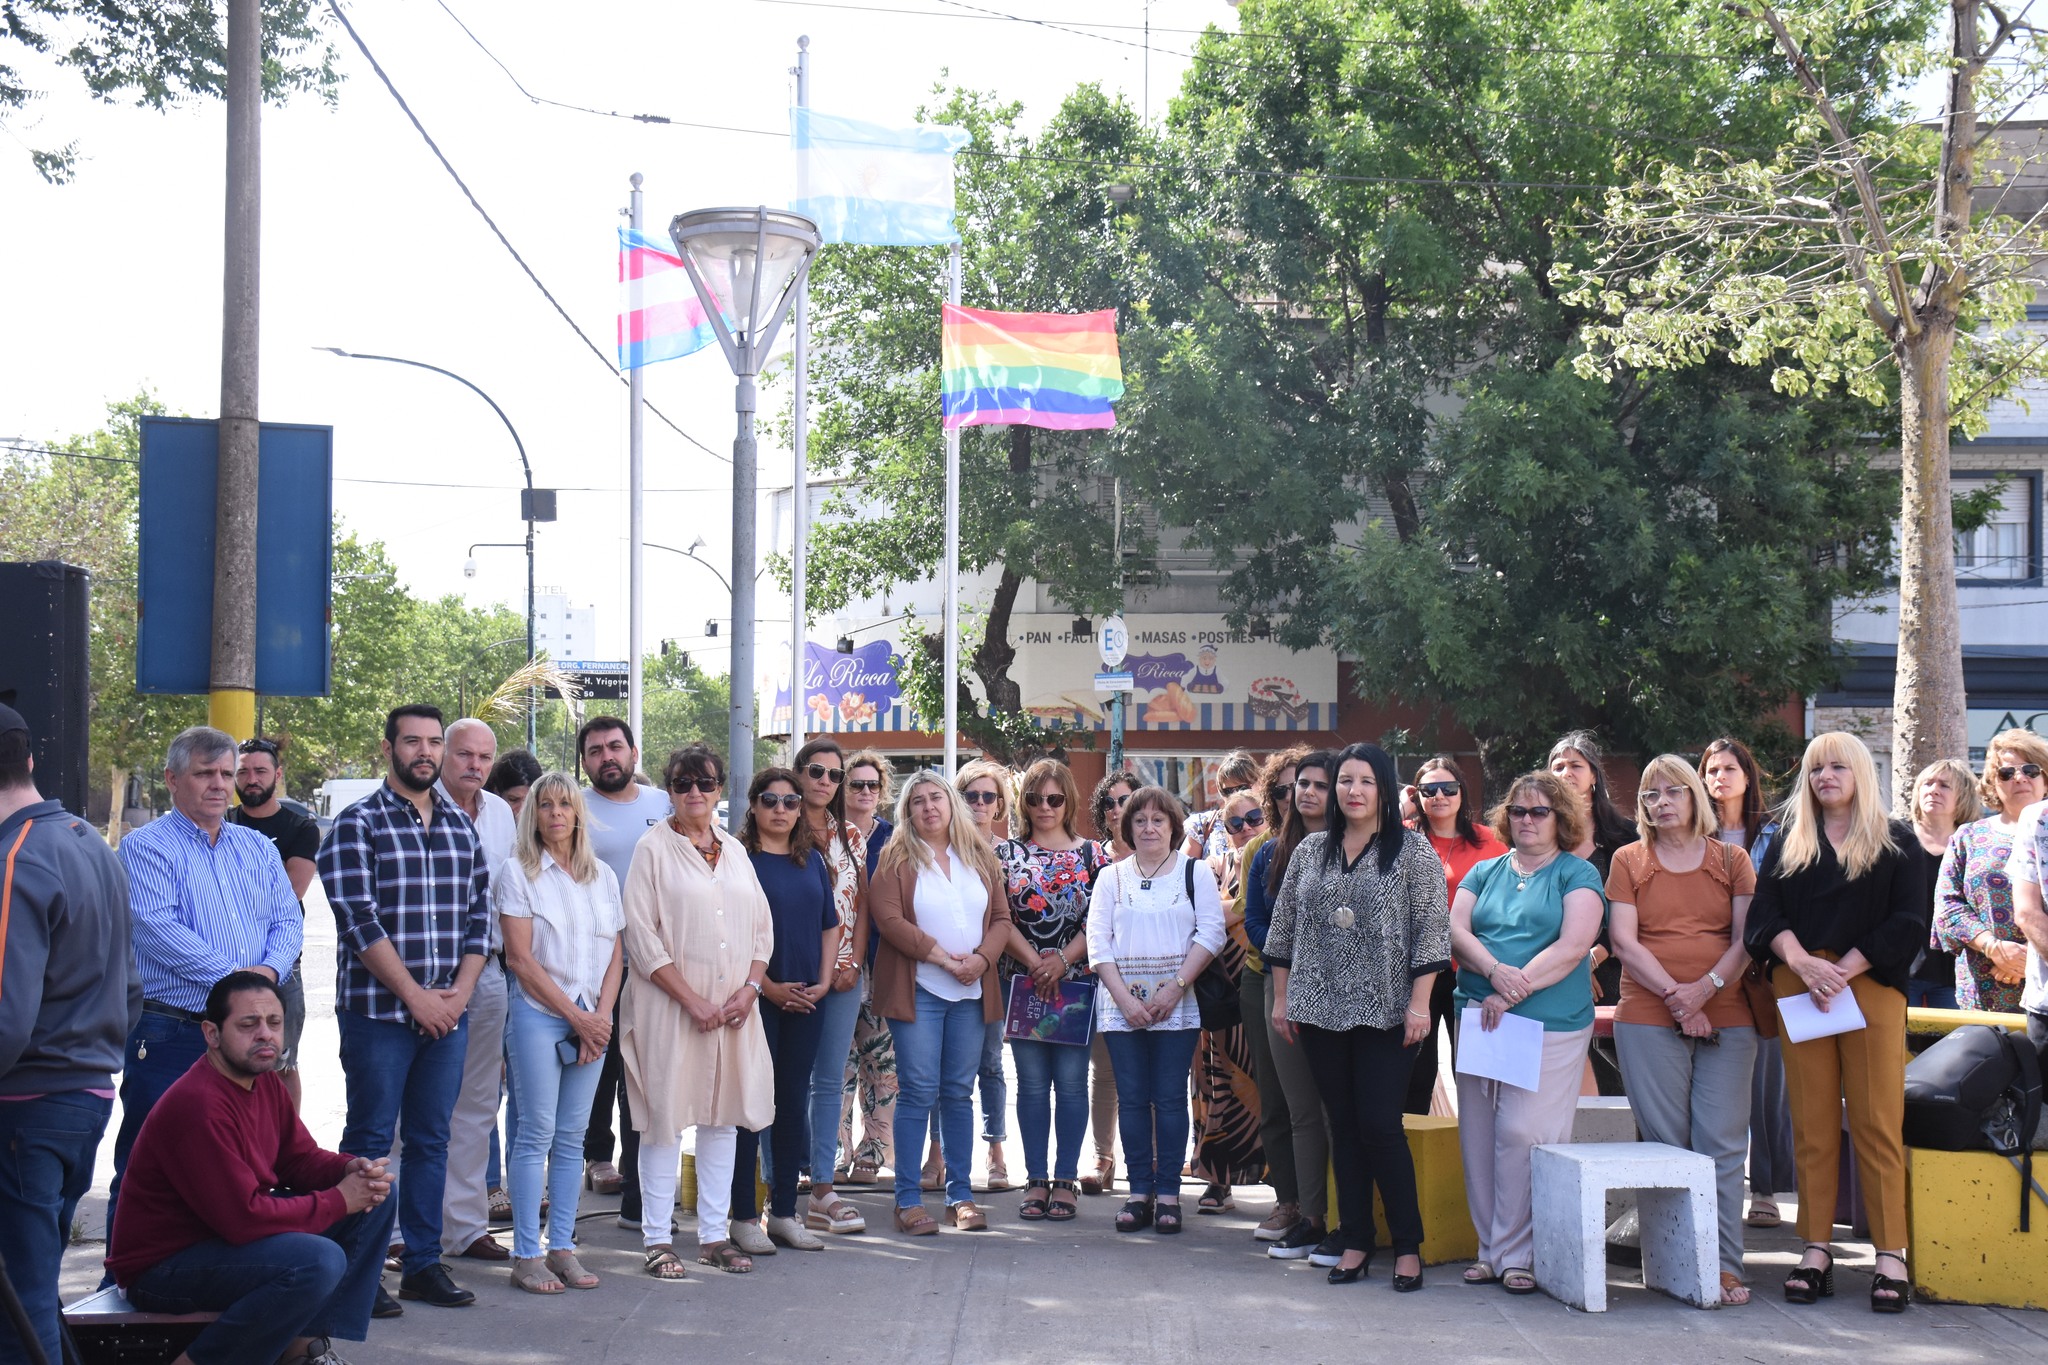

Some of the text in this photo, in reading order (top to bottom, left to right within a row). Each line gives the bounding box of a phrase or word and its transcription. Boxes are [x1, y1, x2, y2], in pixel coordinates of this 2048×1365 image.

[523, 585, 567, 595] HOTEL
[1026, 631, 1052, 644] PAN
[1141, 631, 1187, 644] MASAS
[582, 662, 629, 670] FERNANDE
[829, 657, 893, 688] Ricca
[1137, 661, 1185, 679] Ricca
[584, 677, 629, 687] H. Yrigoye
[1026, 995, 1036, 1019] CALM
